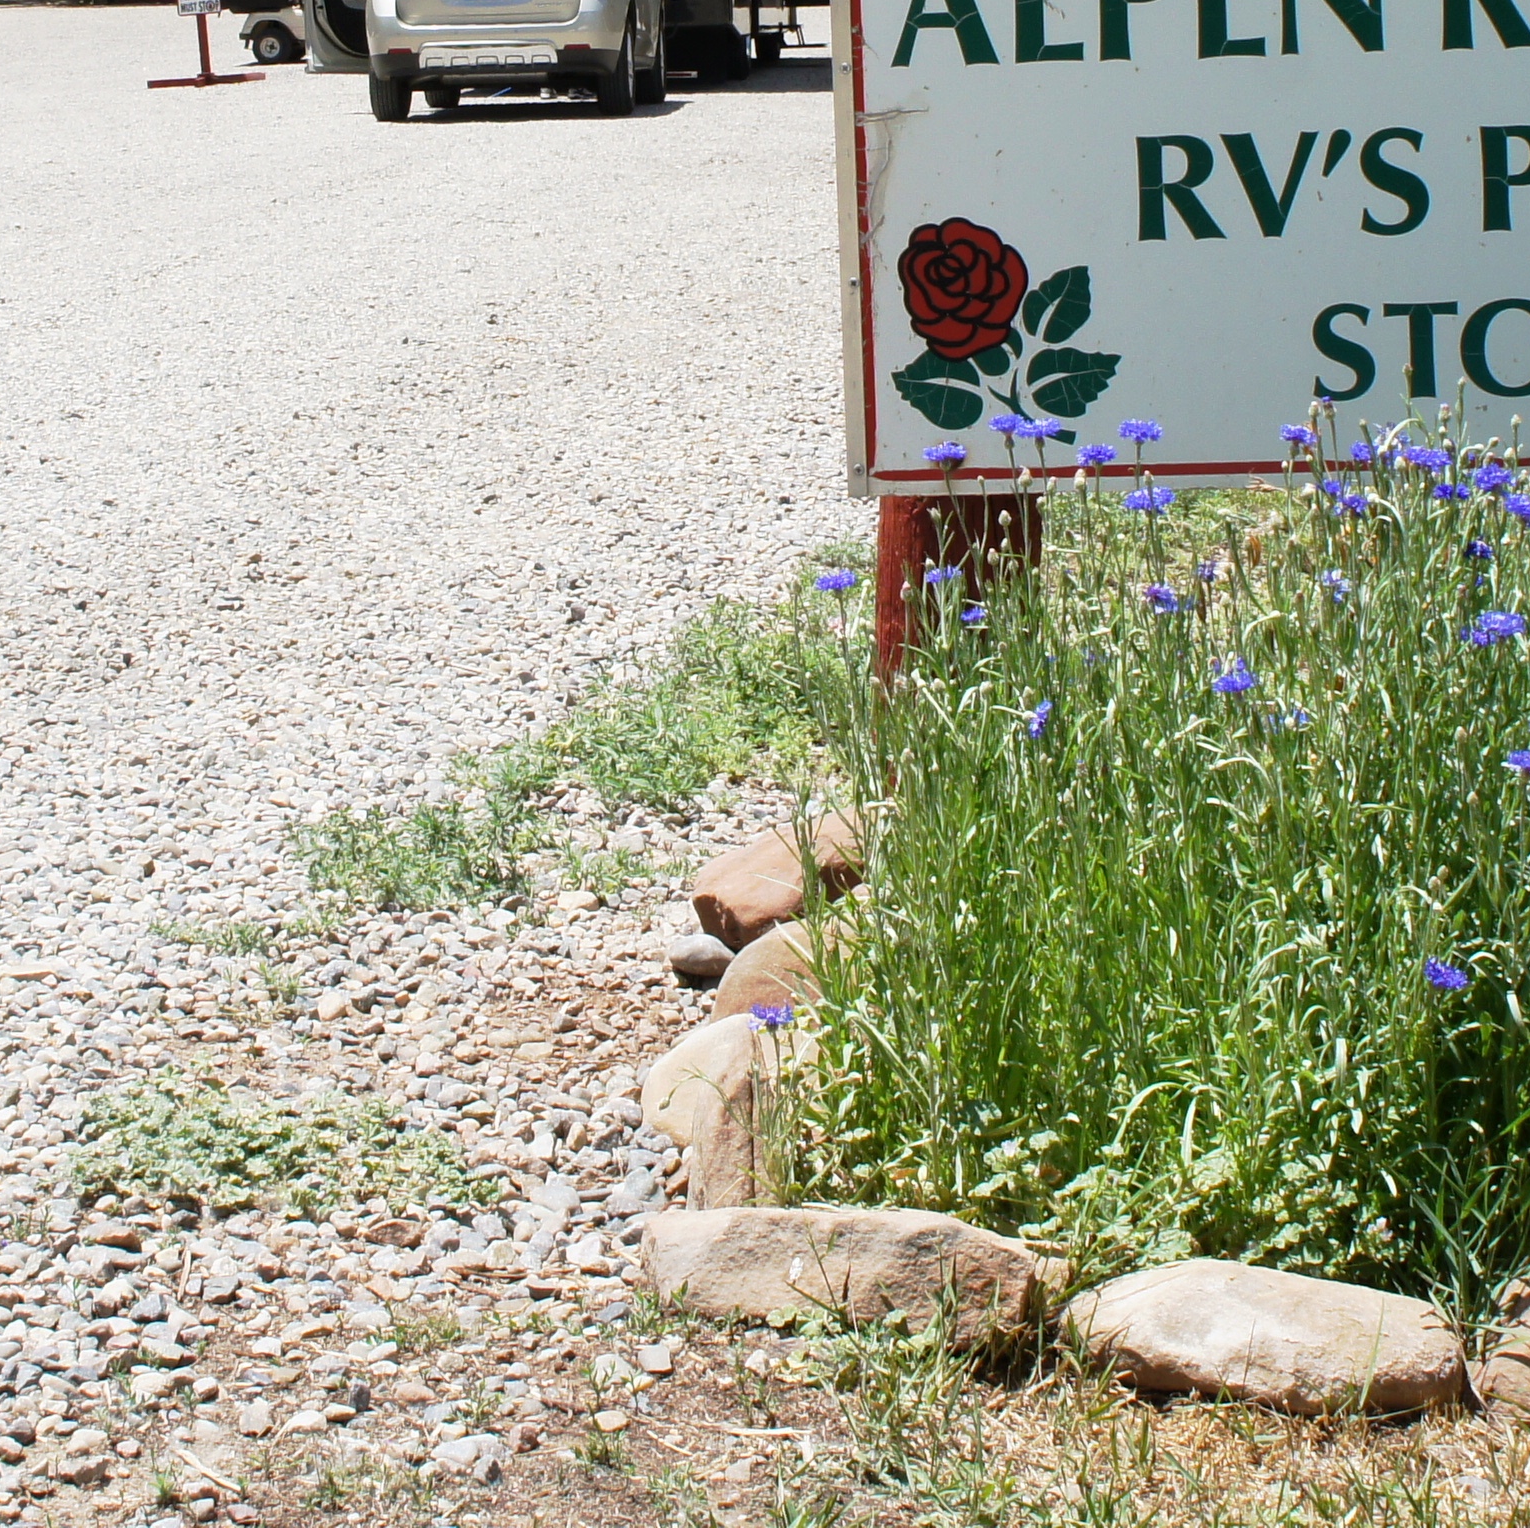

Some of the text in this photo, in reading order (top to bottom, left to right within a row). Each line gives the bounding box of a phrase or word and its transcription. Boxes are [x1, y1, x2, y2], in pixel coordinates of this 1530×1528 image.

[180, 0, 219, 13] MUST STOP
[1136, 127, 1431, 242] RV'S
